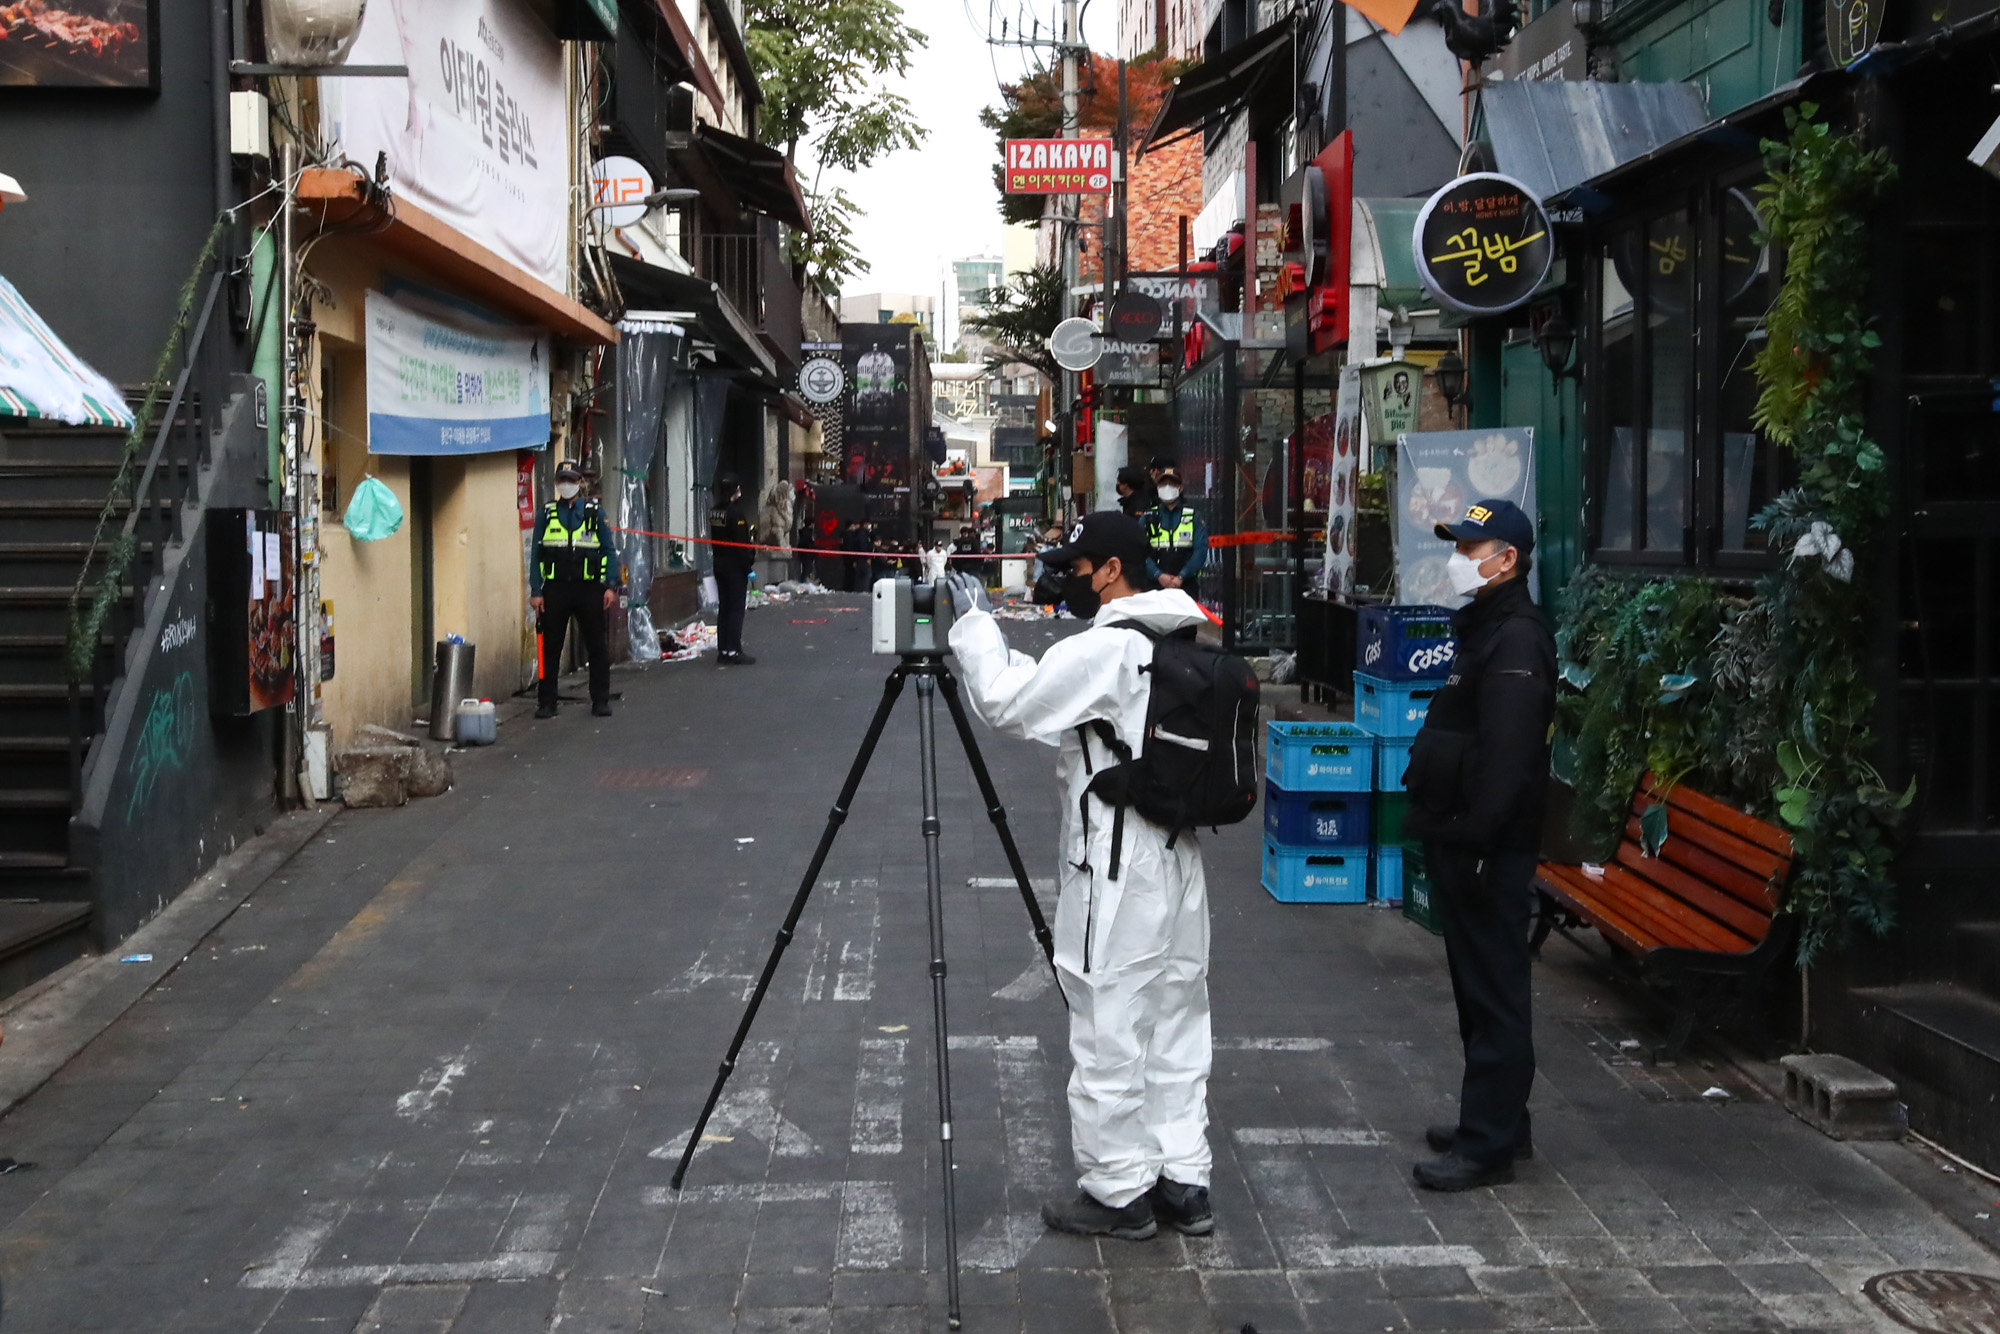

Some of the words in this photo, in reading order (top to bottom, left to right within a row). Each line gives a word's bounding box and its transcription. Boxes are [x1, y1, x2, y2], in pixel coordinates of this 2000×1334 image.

[440, 37, 493, 150] 이태원
[496, 79, 538, 170] 클라쓰
[1010, 143, 1107, 169] IZAKAYA
[593, 177, 643, 203] ZIP
[1093, 177, 1104, 187] 2F
[1431, 226, 1546, 287] 꿀밤
[1122, 356, 1130, 368] 2
